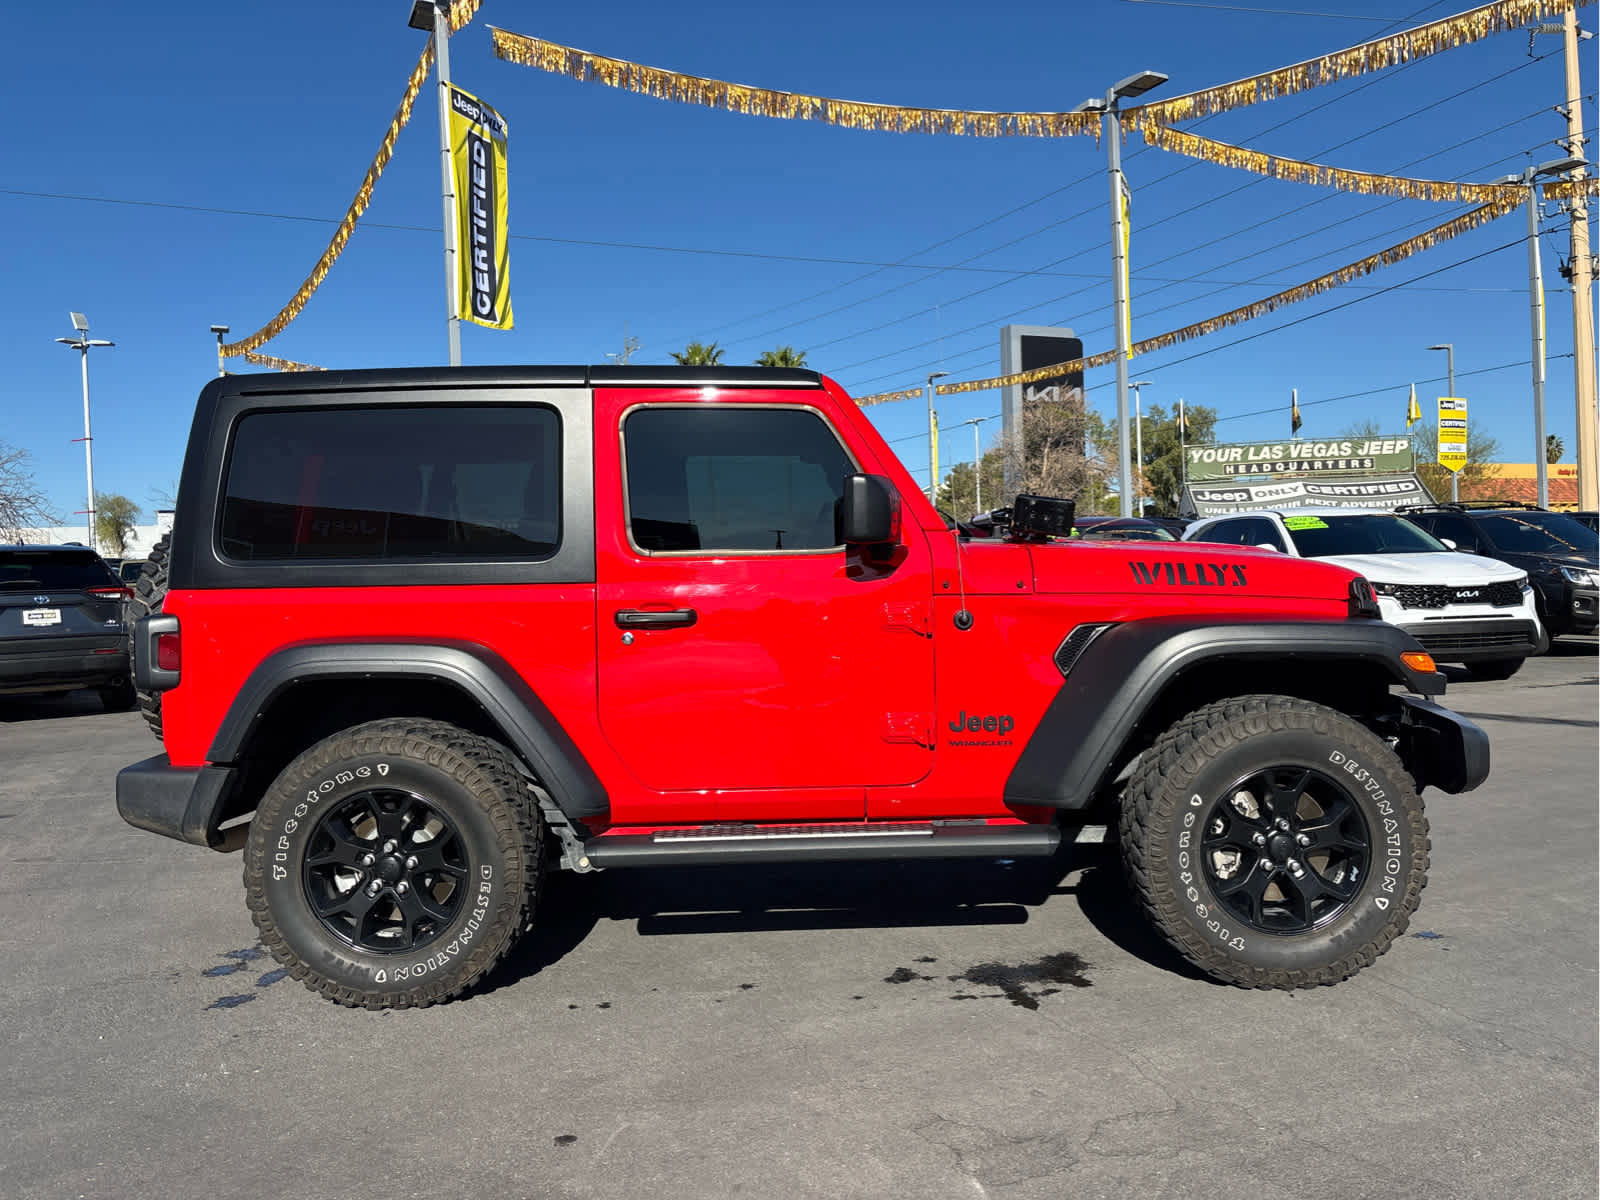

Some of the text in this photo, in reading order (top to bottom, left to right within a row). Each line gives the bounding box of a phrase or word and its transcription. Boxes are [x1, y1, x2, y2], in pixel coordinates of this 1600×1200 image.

[453, 94, 480, 120] Jeep
[473, 140, 491, 316] CERTIFIED
[1191, 440, 1409, 463] YOUR LAS VEGAS JEEP
[1226, 459, 1372, 474] HEADQUARTERS
[1196, 482, 1416, 501] Jeep ONLY CERTIFIED
[1305, 498, 1338, 507] NEXT
[1341, 497, 1421, 508] ADVENTURE
[1128, 561, 1248, 587] WILLYS
[1456, 590, 1480, 598] KIA
[948, 710, 1015, 736] Jeep
[272, 766, 372, 881] Firestone
[1328, 750, 1401, 893] DESTINATION
[1179, 811, 1246, 951] Firestone
[394, 864, 493, 982] DESTINATION
